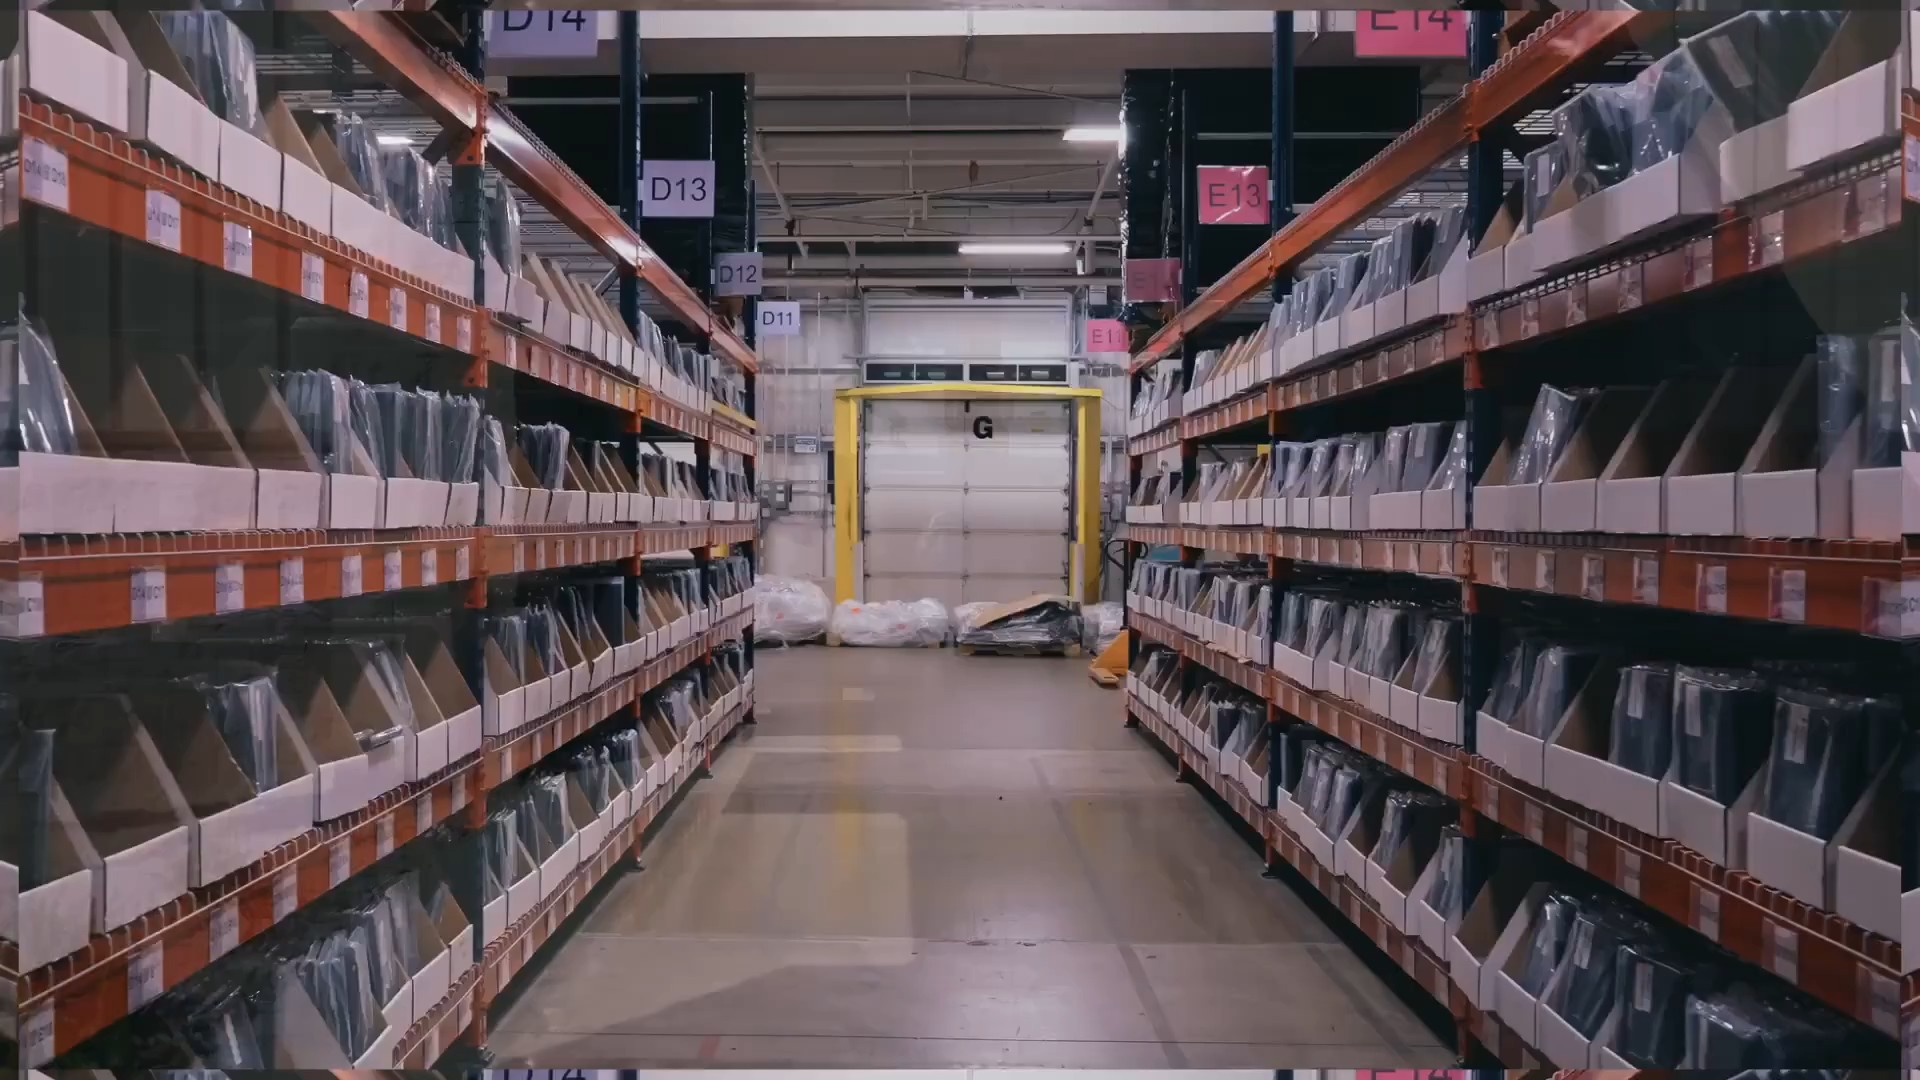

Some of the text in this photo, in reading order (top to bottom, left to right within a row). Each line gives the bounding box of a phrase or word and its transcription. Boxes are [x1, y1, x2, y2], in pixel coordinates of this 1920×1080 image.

[503, 10, 586, 31] D14
[651, 177, 707, 202] D13
[1209, 183, 1262, 207] E13
[719, 265, 757, 284] D12
[762, 311, 792, 326] D11
[973, 415, 993, 439] G
